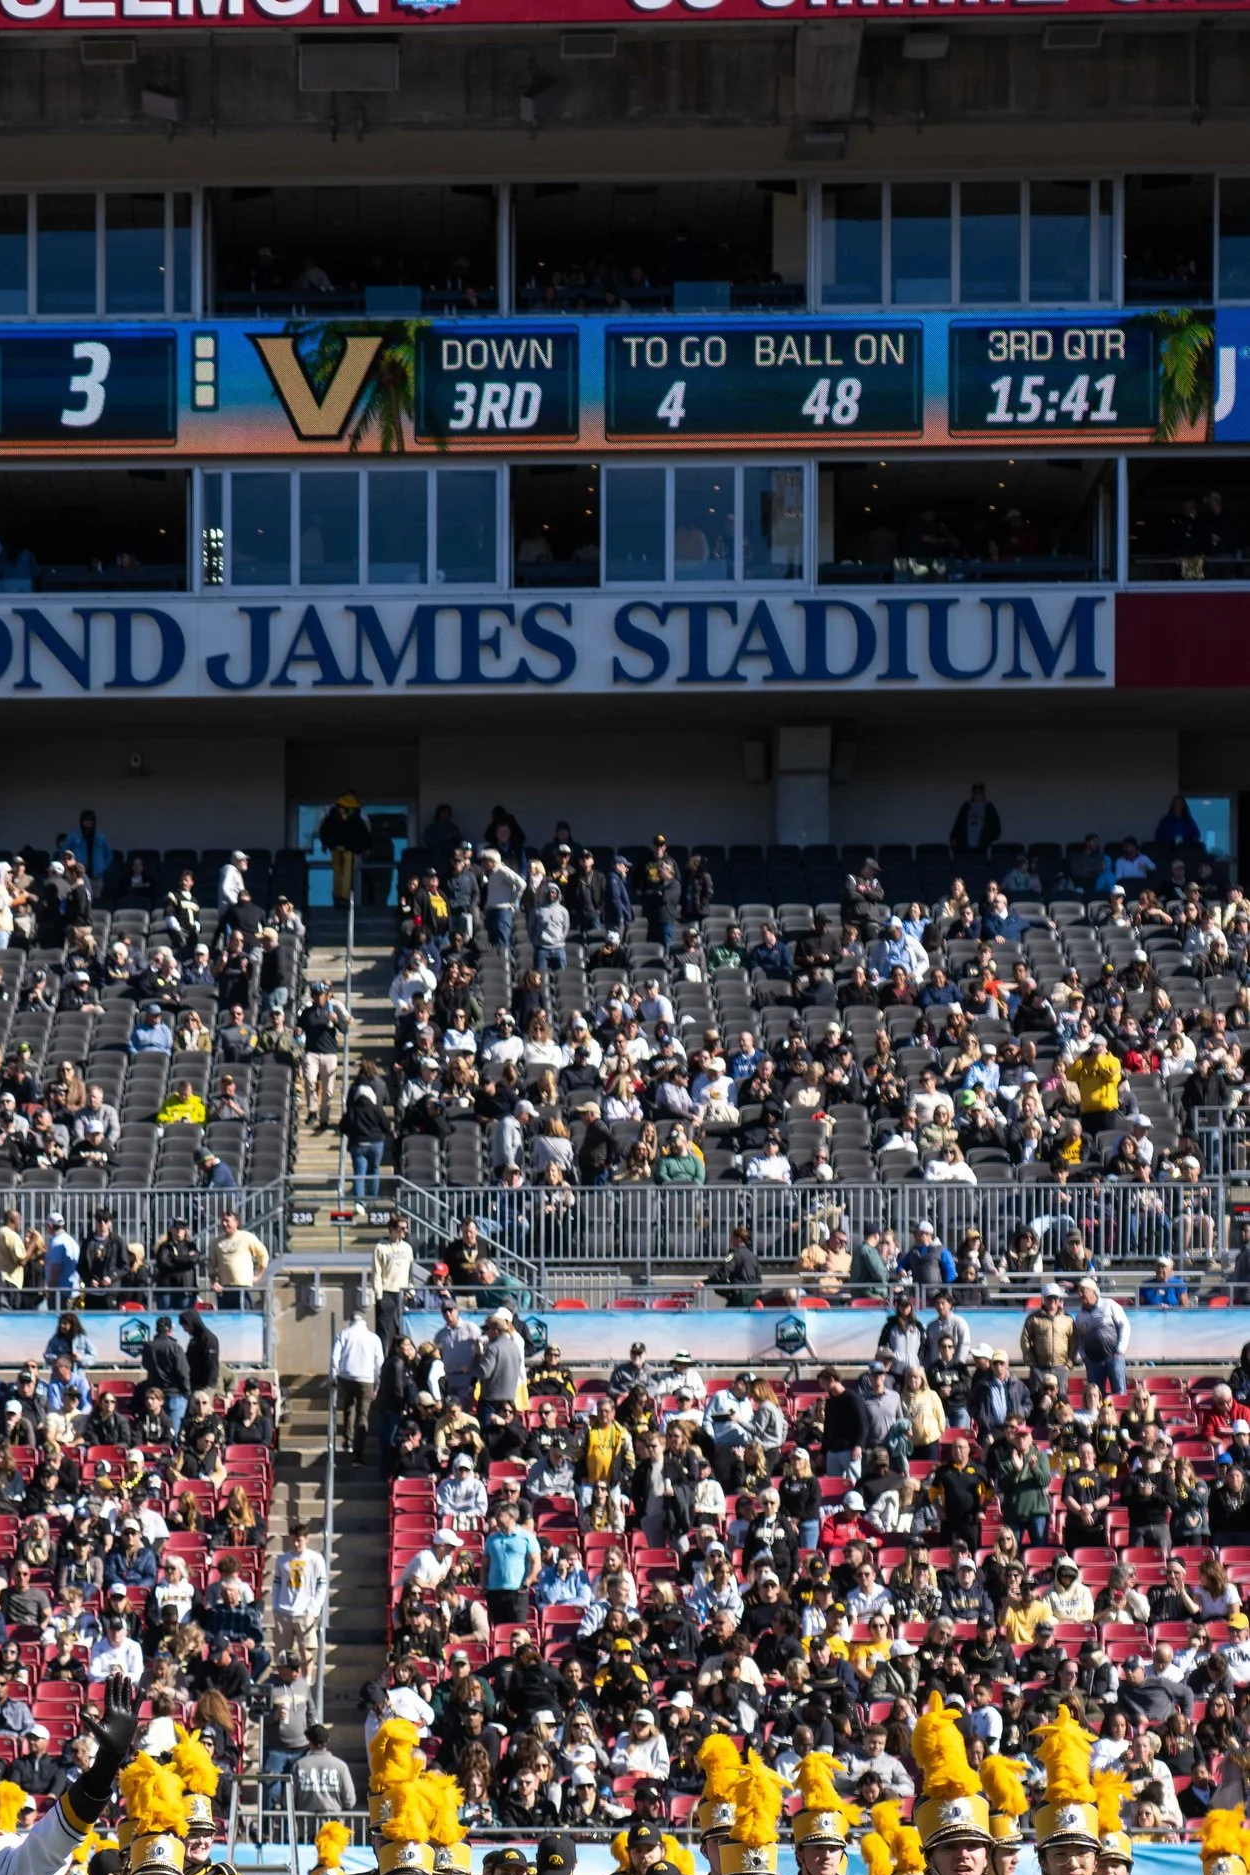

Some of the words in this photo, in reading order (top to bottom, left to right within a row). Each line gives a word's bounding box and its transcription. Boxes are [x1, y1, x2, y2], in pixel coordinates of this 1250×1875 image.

[442, 338, 554, 371] DOWN
[622, 337, 668, 368] TO
[680, 336, 727, 367] GO
[755, 335, 843, 366] BALL
[855, 333, 904, 364] ON
[988, 329, 1054, 362] 3RD
[1063, 328, 1126, 361] QTR
[60, 342, 112, 428] 3
[449, 381, 543, 430] 3RD
[656, 380, 687, 428] 4
[801, 377, 862, 426] 48
[986, 374, 1118, 423] 15:41
[205, 602, 578, 691] JAMES
[612, 597, 1106, 685] STADIUM
